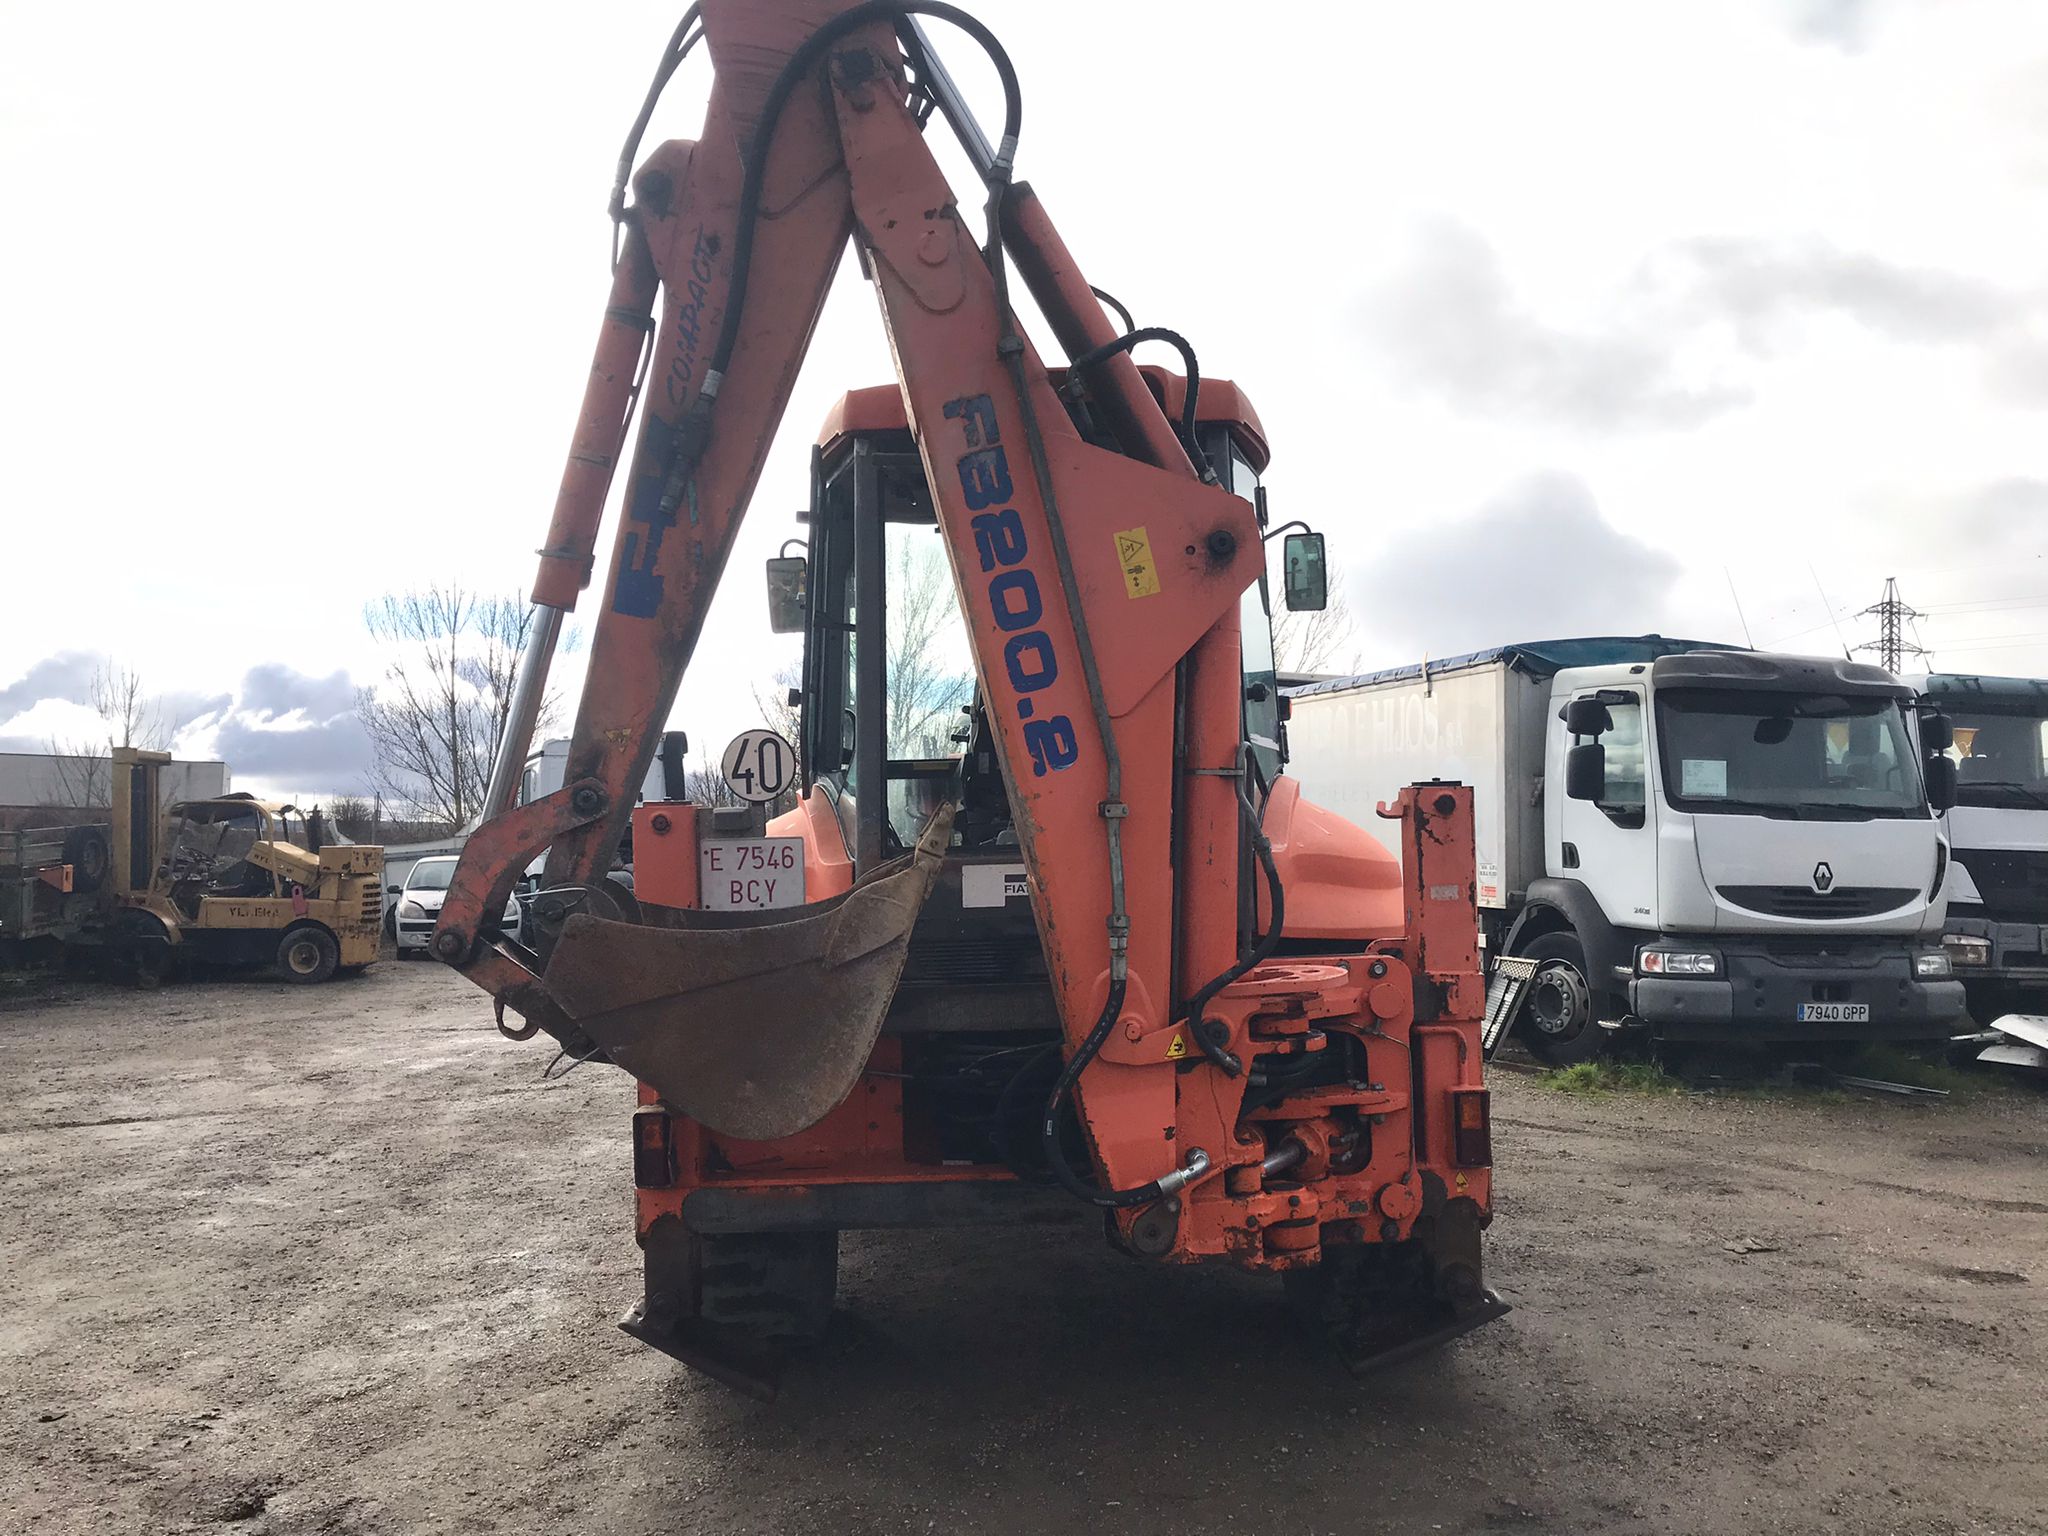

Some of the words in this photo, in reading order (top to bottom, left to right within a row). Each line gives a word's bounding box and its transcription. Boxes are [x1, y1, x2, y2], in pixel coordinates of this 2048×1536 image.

[943, 392, 1078, 778] FB200.2
[731, 737, 782, 795] 40
[711, 848, 723, 871] E
[737, 846, 794, 870] 7546
[730, 879, 777, 904] BCY
[1807, 1006, 1839, 1020] 7940
[1843, 1006, 1867, 1020] GPP
